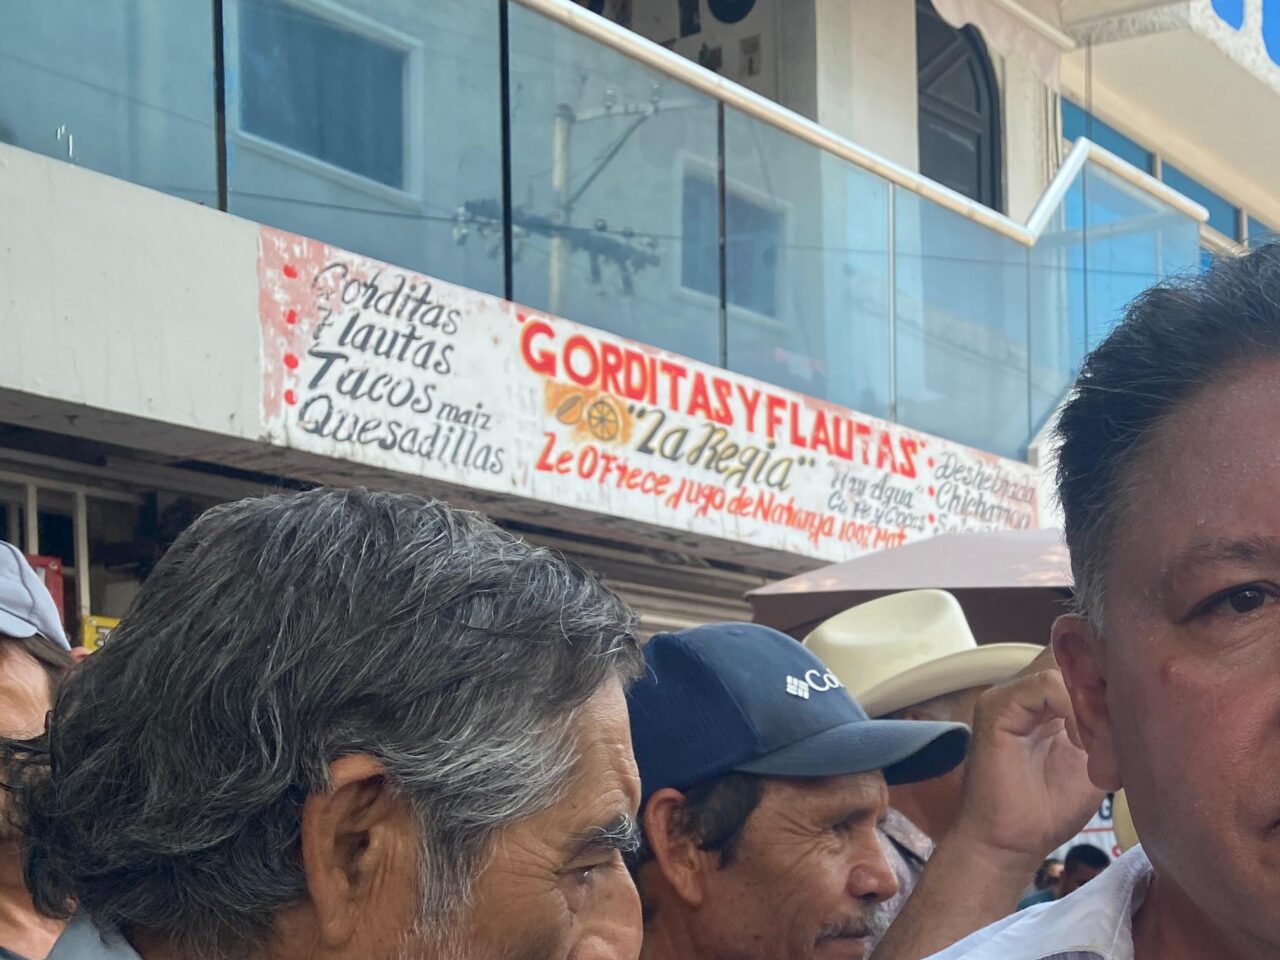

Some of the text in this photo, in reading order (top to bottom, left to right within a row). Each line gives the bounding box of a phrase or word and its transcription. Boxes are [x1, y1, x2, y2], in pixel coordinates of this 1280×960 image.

[307, 343, 437, 414] Tacos
[736, 384, 762, 433] Y
[299, 394, 505, 475] Quesadillas
